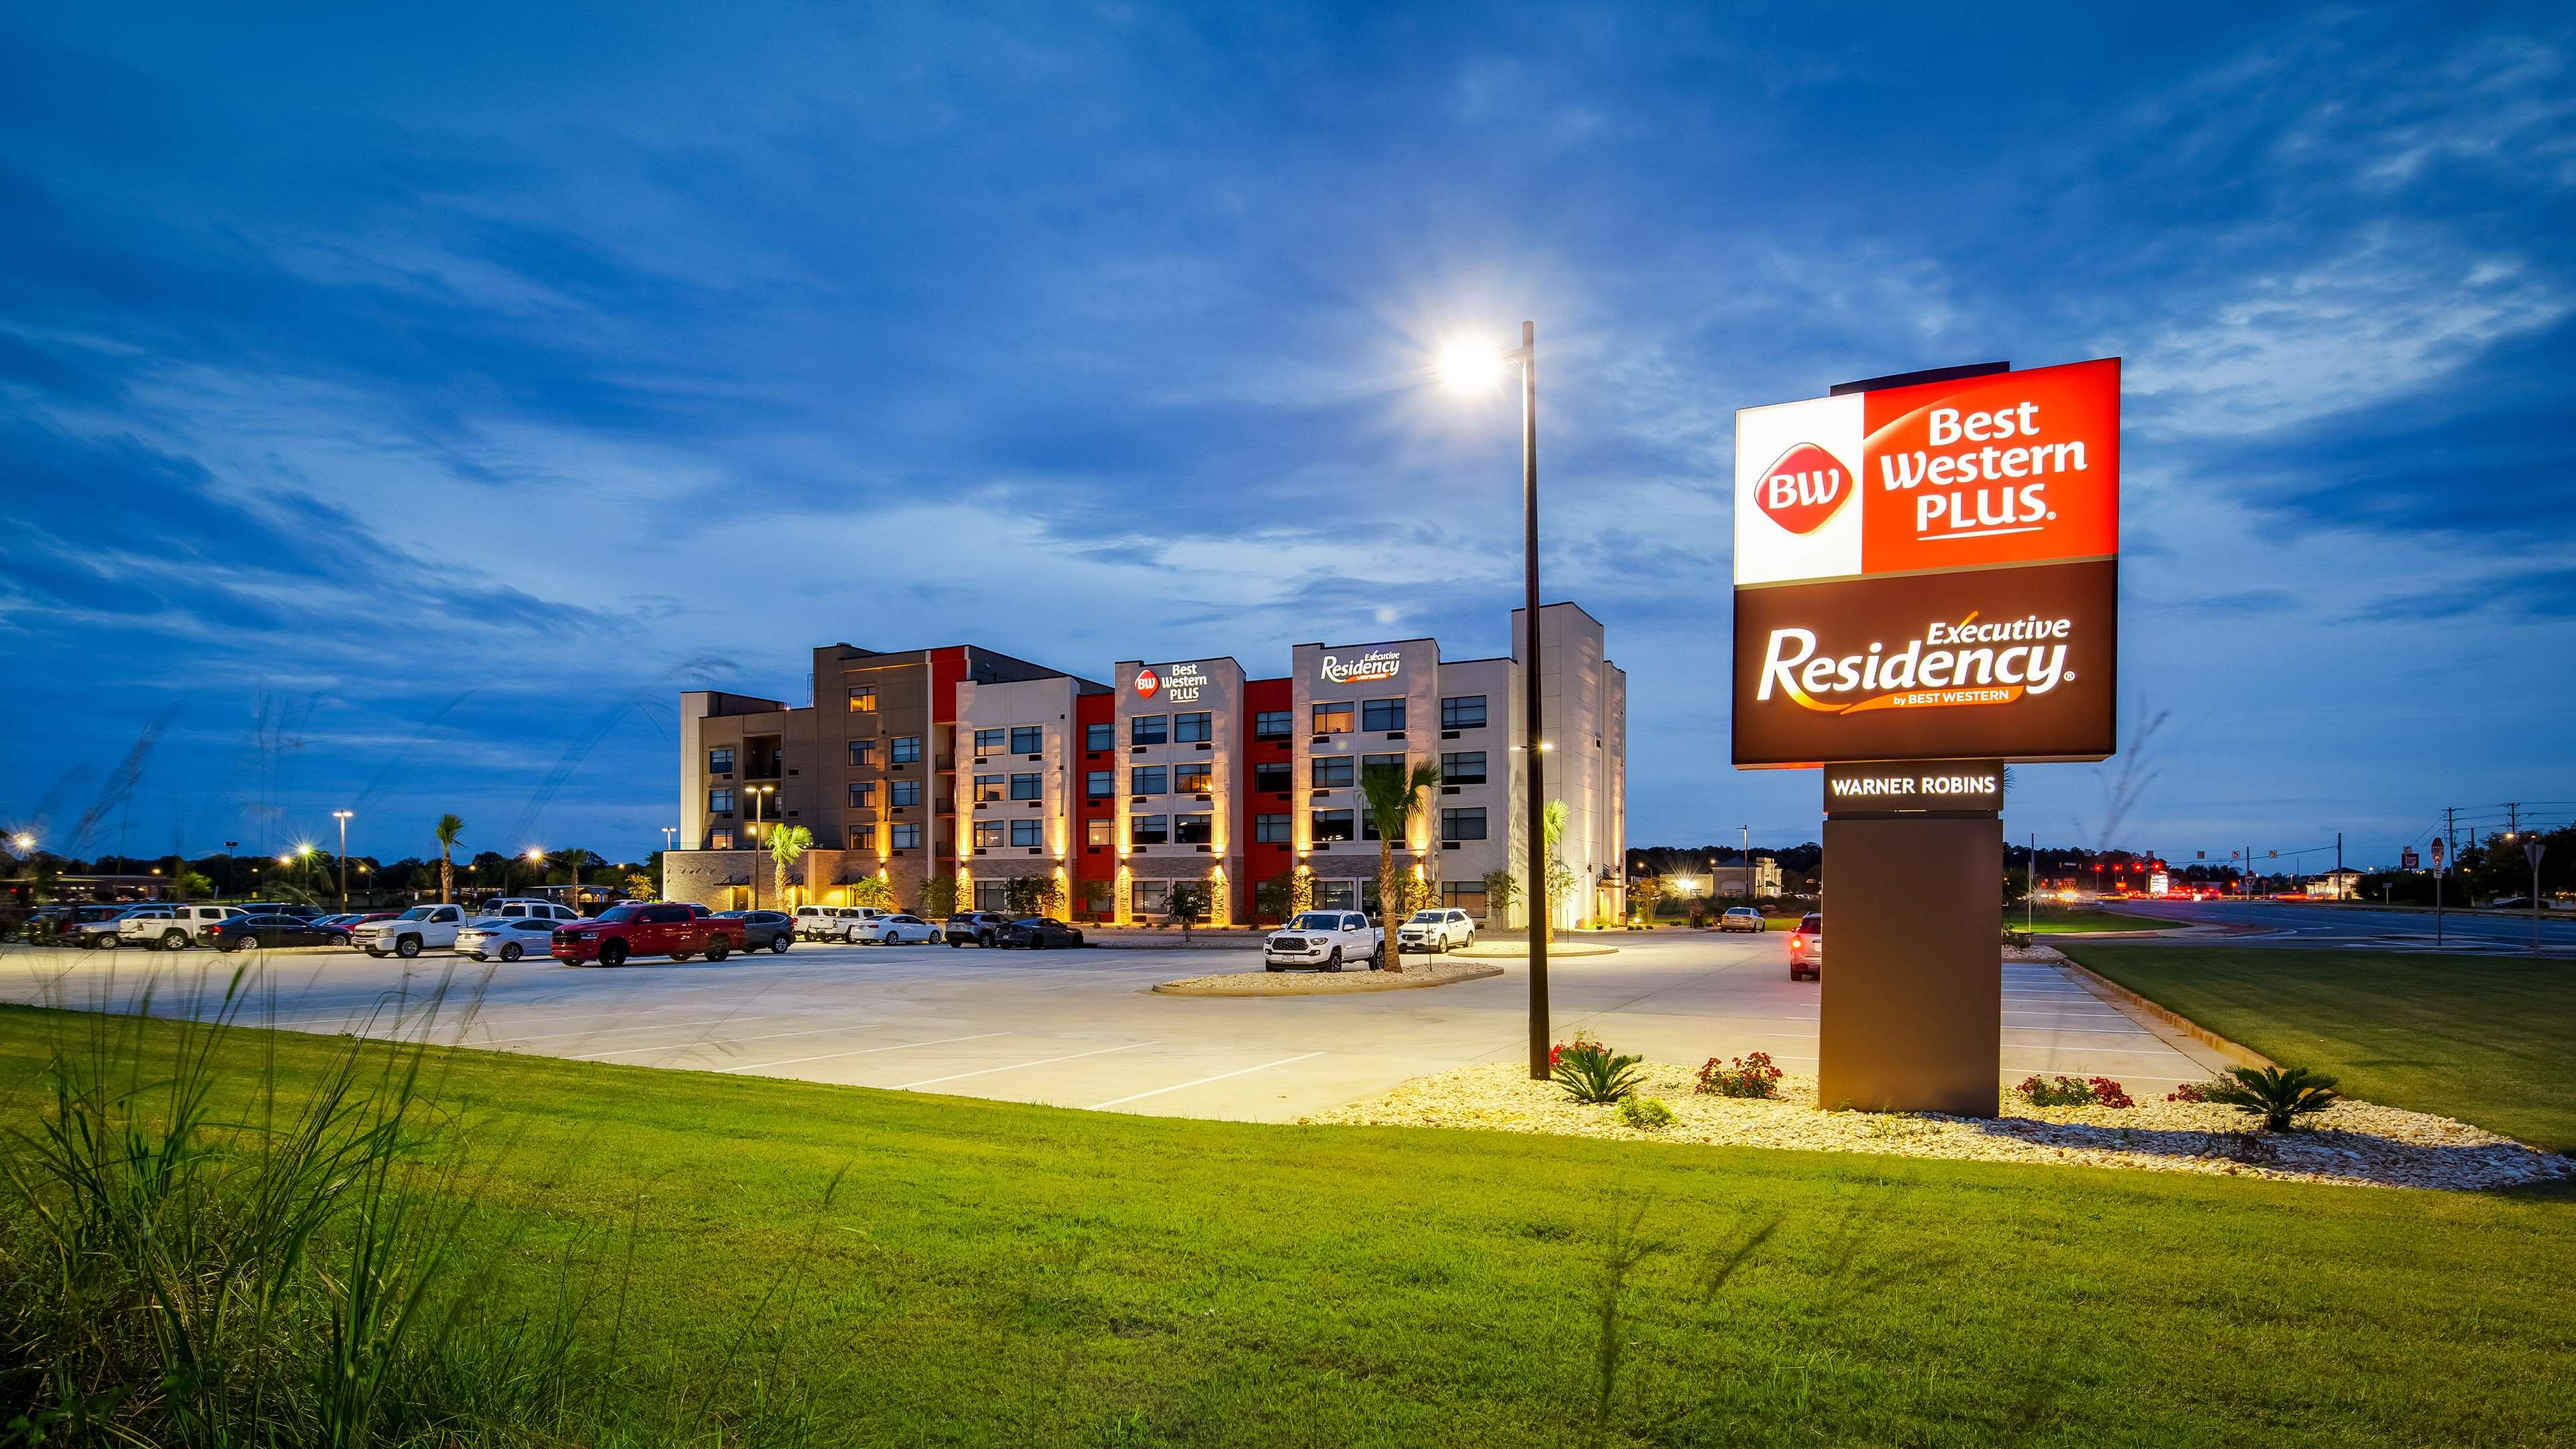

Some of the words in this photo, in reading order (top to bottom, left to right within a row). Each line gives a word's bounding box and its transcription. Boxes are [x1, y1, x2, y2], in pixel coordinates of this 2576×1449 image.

[1929, 401, 2040, 446] Best
[1880, 440, 2088, 492] Western
[1768, 469, 1839, 509] BW
[1927, 611, 2072, 645] Executive
[1364, 650, 1400, 661] Executive
[1172, 663, 1197, 676] Best
[1320, 655, 1400, 683] Residency
[1137, 678, 1156, 690] BW
[1161, 676, 1208, 688] Western
[1170, 687, 1199, 700] PLUS
[1893, 696, 1907, 706] by
[1908, 692, 1941, 704] BEST
[1943, 689, 2009, 703] WESTERN
[1831, 778, 1916, 796] WARNER
[1921, 776, 1996, 794] ROBINS
[2432, 846, 2443, 855] STOP
